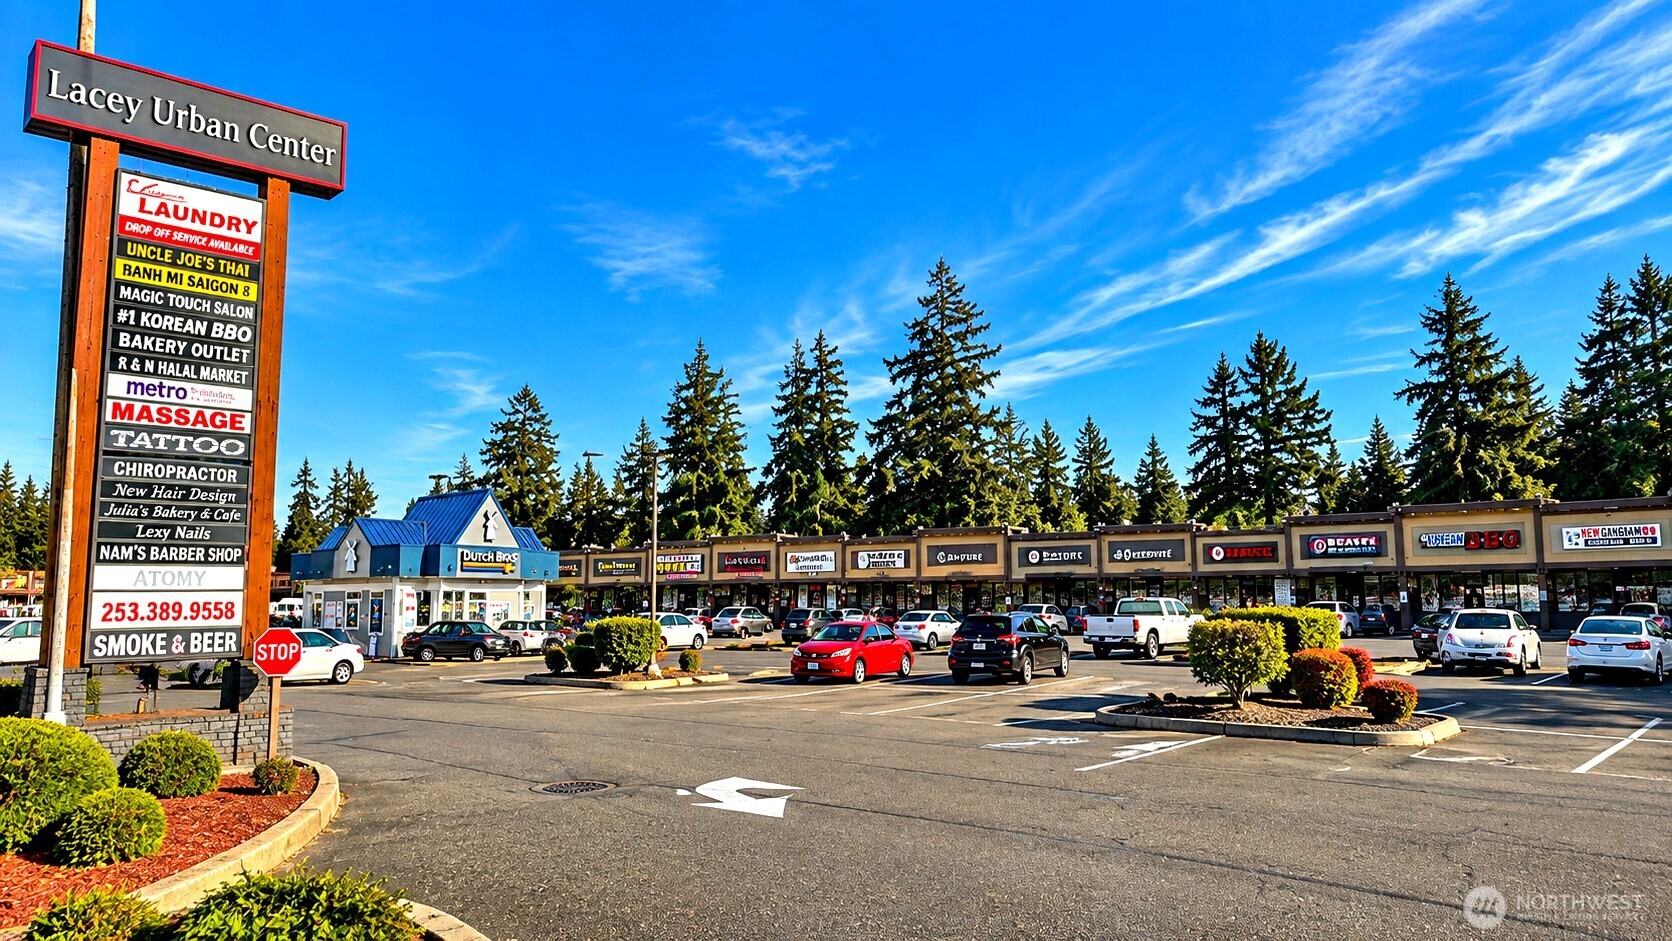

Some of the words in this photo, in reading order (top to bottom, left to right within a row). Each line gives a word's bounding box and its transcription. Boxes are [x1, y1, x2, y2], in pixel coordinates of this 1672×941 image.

[48, 69, 143, 123] Lacey
[152, 97, 240, 143] Urban
[249, 123, 336, 166] Center
[138, 197, 258, 235] LAUNDRY
[125, 222, 152, 234] DROP
[154, 227, 170, 238] OFF
[173, 232, 207, 247] SERVICE
[209, 239, 255, 255] AVAILABLE
[127, 242, 172, 262] UNCLE
[177, 252, 215, 271] JOE'S
[218, 260, 250, 277] THAI
[122, 264, 162, 282] BANH
[166, 272, 183, 286] MI
[187, 275, 238, 295] SAIGON
[243, 285, 250, 297] 8
[120, 286, 164, 303] MAGIC
[167, 294, 210, 312] TOUCH
[214, 302, 253, 319] SALON
[117, 309, 135, 324] #1
[141, 312, 207, 336] KOREAN
[119, 333, 187, 355] BAKERY
[192, 345, 250, 363] OUTLET
[130, 358, 141, 371] &
[144, 359, 154, 373] N
[158, 361, 197, 379] HALAL
[199, 367, 248, 384] MARKET
[126, 381, 188, 400] metro
[111, 402, 245, 430] MASSAGE
[110, 430, 245, 456] TATTOO
[113, 461, 238, 482] CHIROPRACTOR
[112, 484, 148, 498] New
[150, 486, 186, 500] Hair
[189, 488, 237, 504] Design
[104, 504, 148, 518] Julia's
[152, 506, 198, 521] Bakery
[201, 508, 212, 519] &
[214, 509, 241, 523] Cafe
[135, 524, 171, 540] Lexy
[174, 526, 211, 540] Nails
[100, 545, 146, 560] NAM'S
[150, 547, 204, 562] BARBER
[208, 548, 242, 562] SHOP
[463, 550, 494, 562] DUTCH
[132, 570, 207, 587] ATOMY
[101, 601, 235, 622] 253.389.9558
[93, 633, 167, 657] SMOKE
[171, 634, 186, 654] &
[190, 632, 237, 653] BEER
[257, 642, 300, 660] STOP
